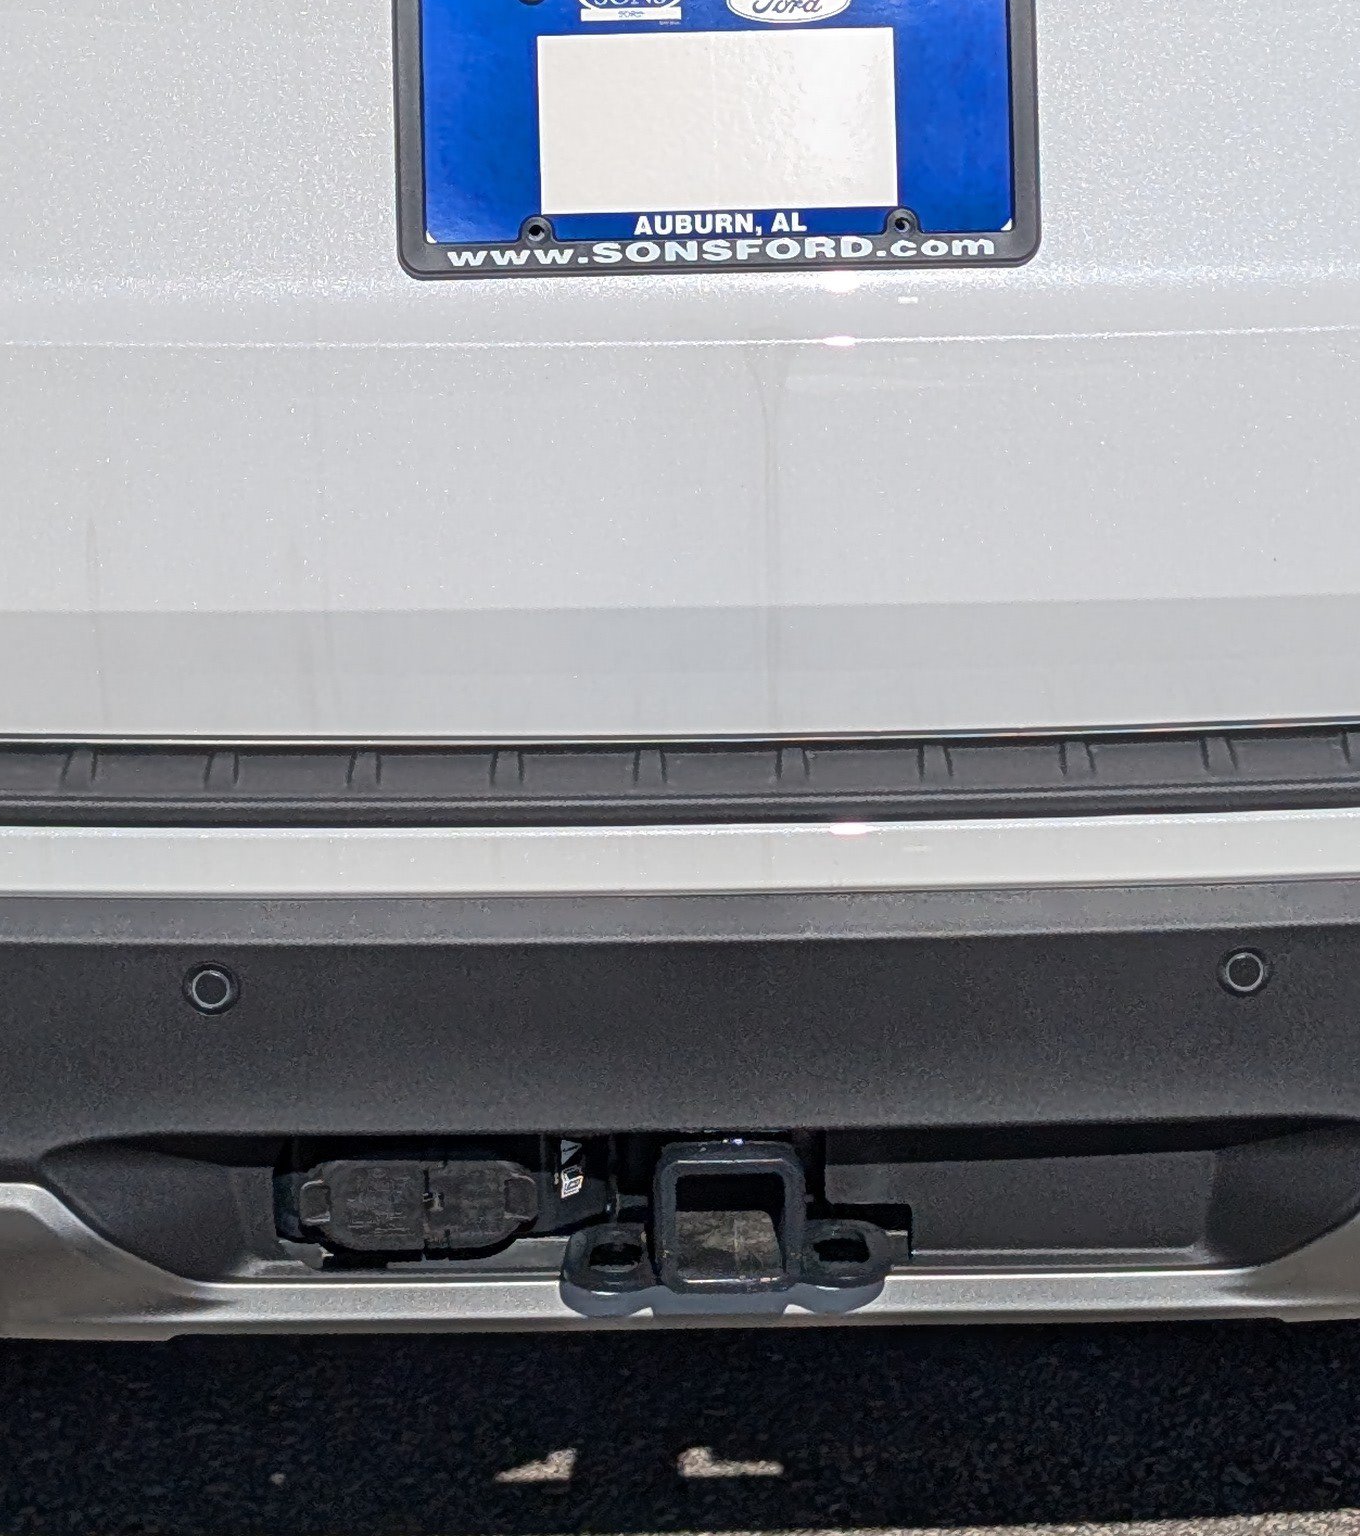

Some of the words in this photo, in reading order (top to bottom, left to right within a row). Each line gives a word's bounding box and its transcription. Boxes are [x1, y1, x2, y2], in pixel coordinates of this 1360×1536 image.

[633, 213, 764, 237] AUBURN,
[771, 210, 808, 233] AL
[446, 234, 996, 268] www.SONSFORD.com
